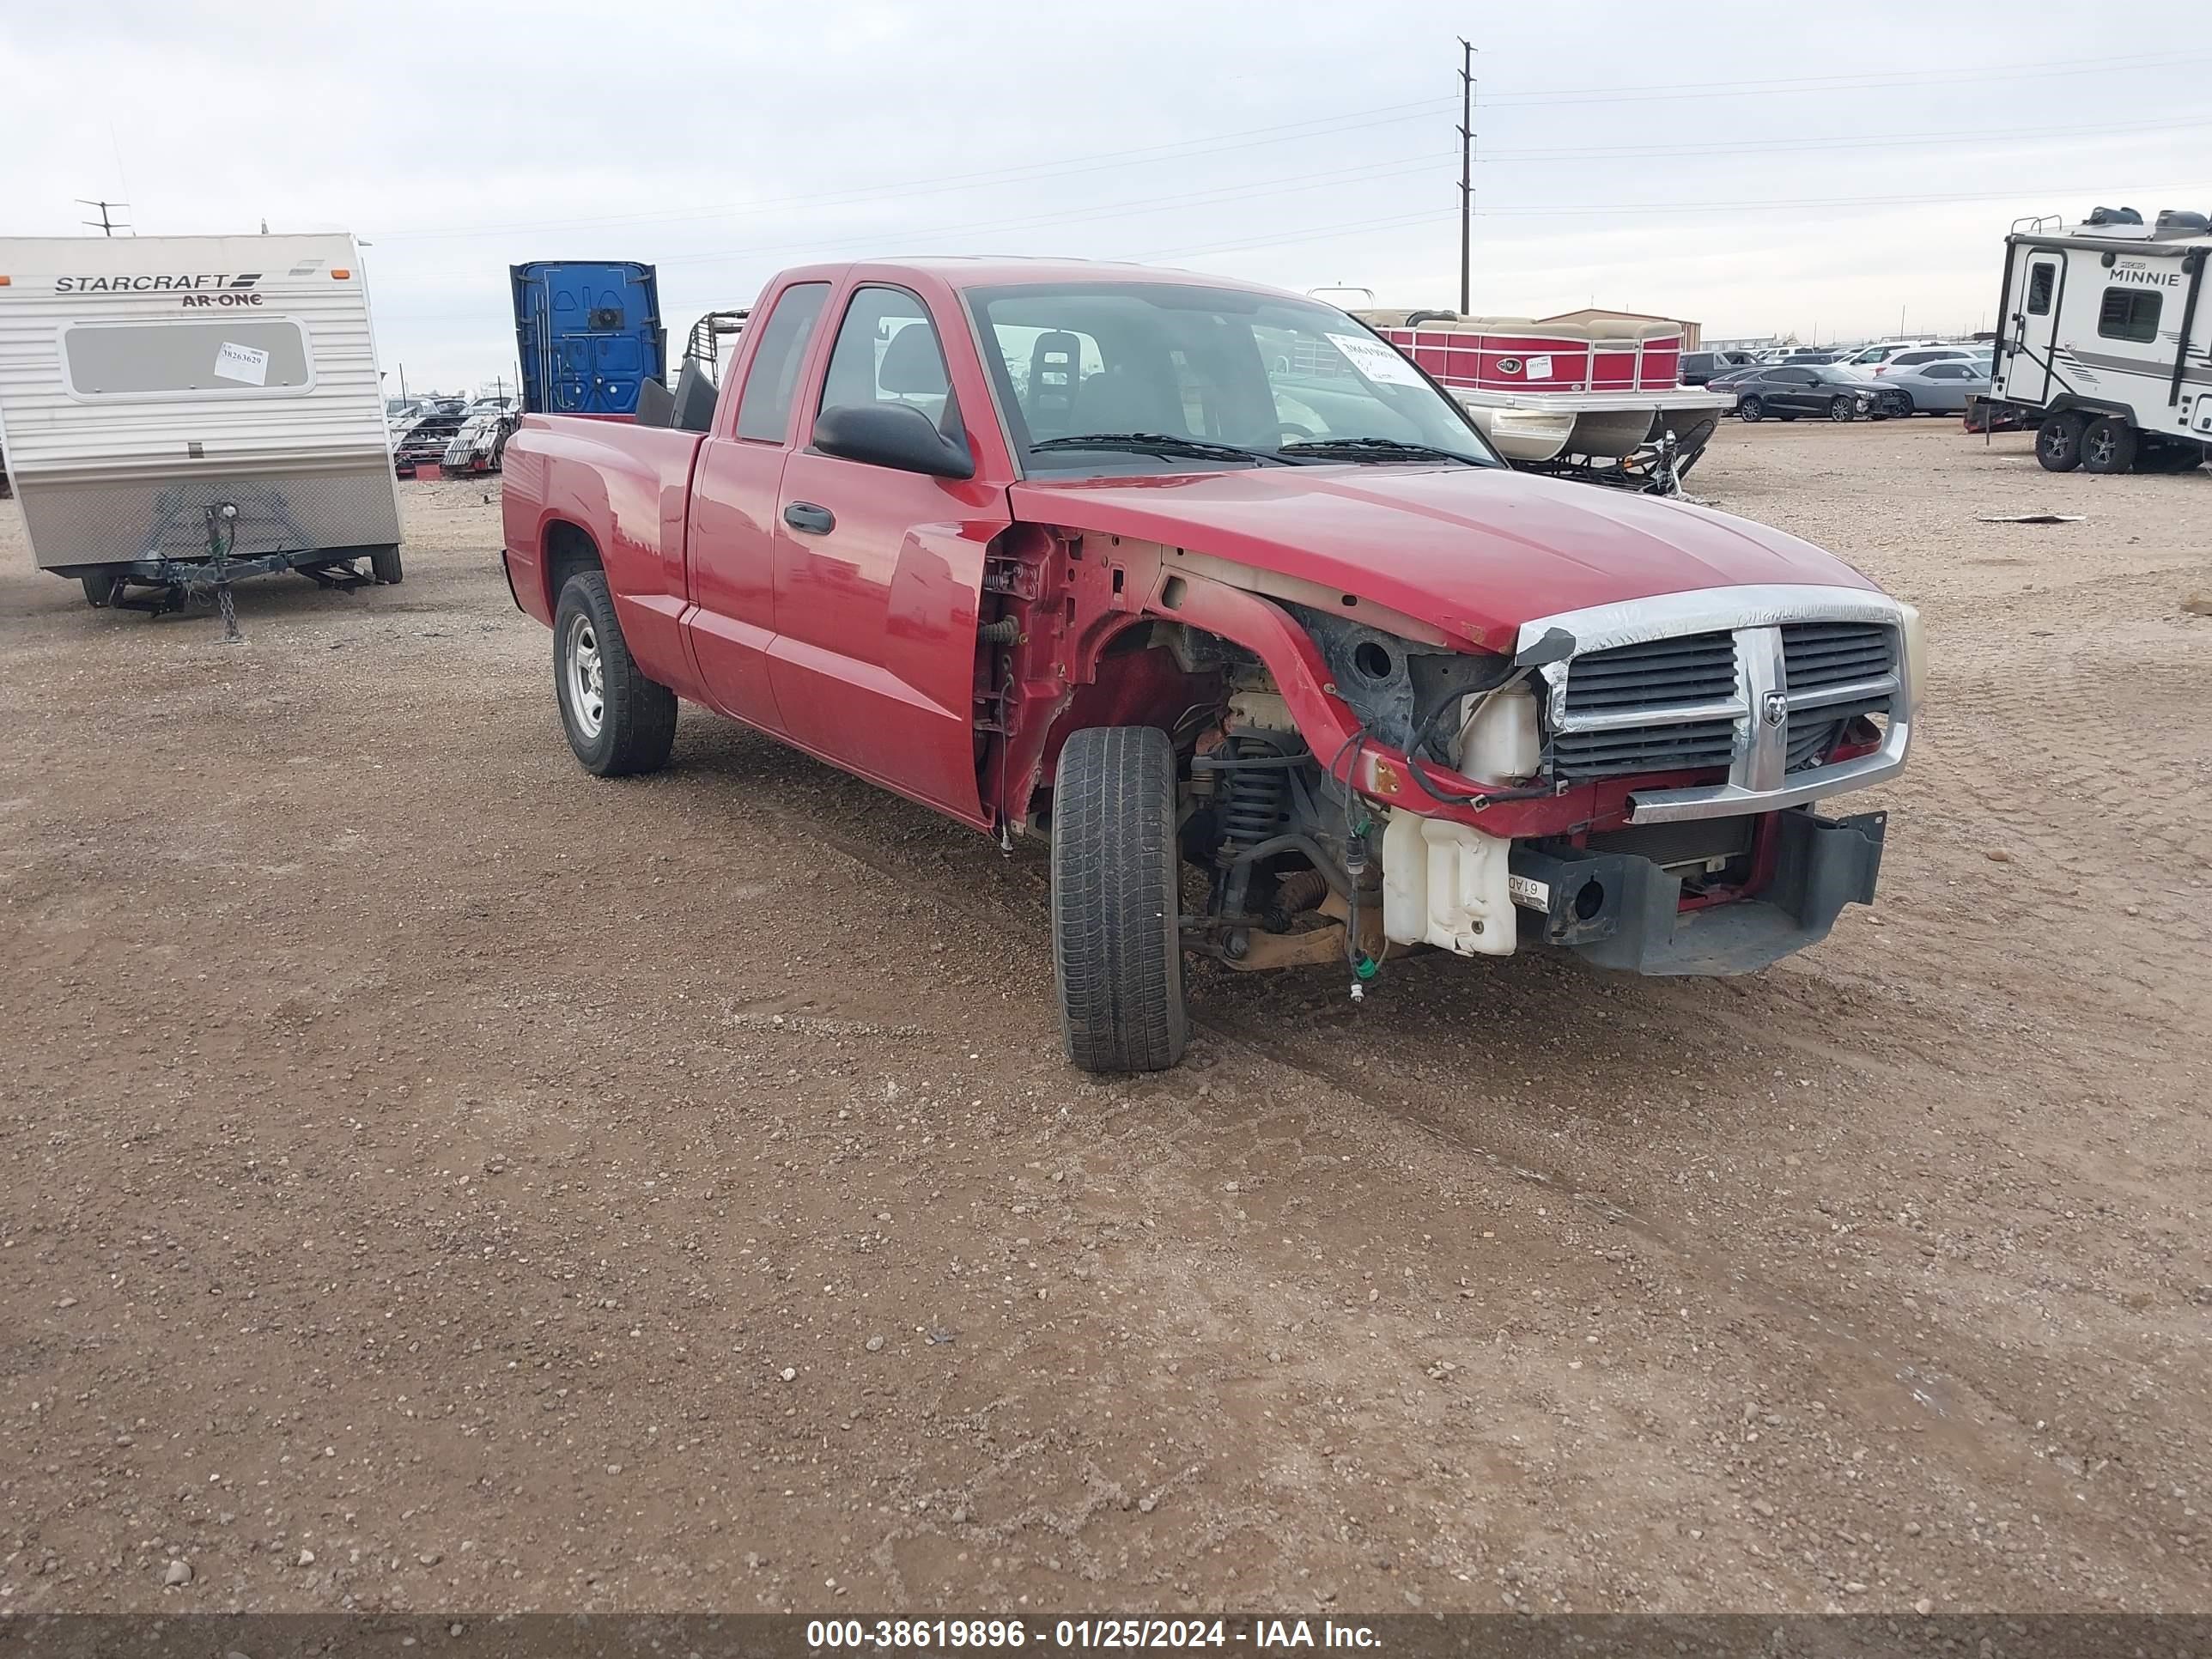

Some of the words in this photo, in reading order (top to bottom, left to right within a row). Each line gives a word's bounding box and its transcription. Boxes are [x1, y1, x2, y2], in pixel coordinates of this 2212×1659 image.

[55, 274, 230, 292] STARCRAFT
[2109, 269, 2181, 287] MINNIE
[182, 294, 263, 307] AR-ONE
